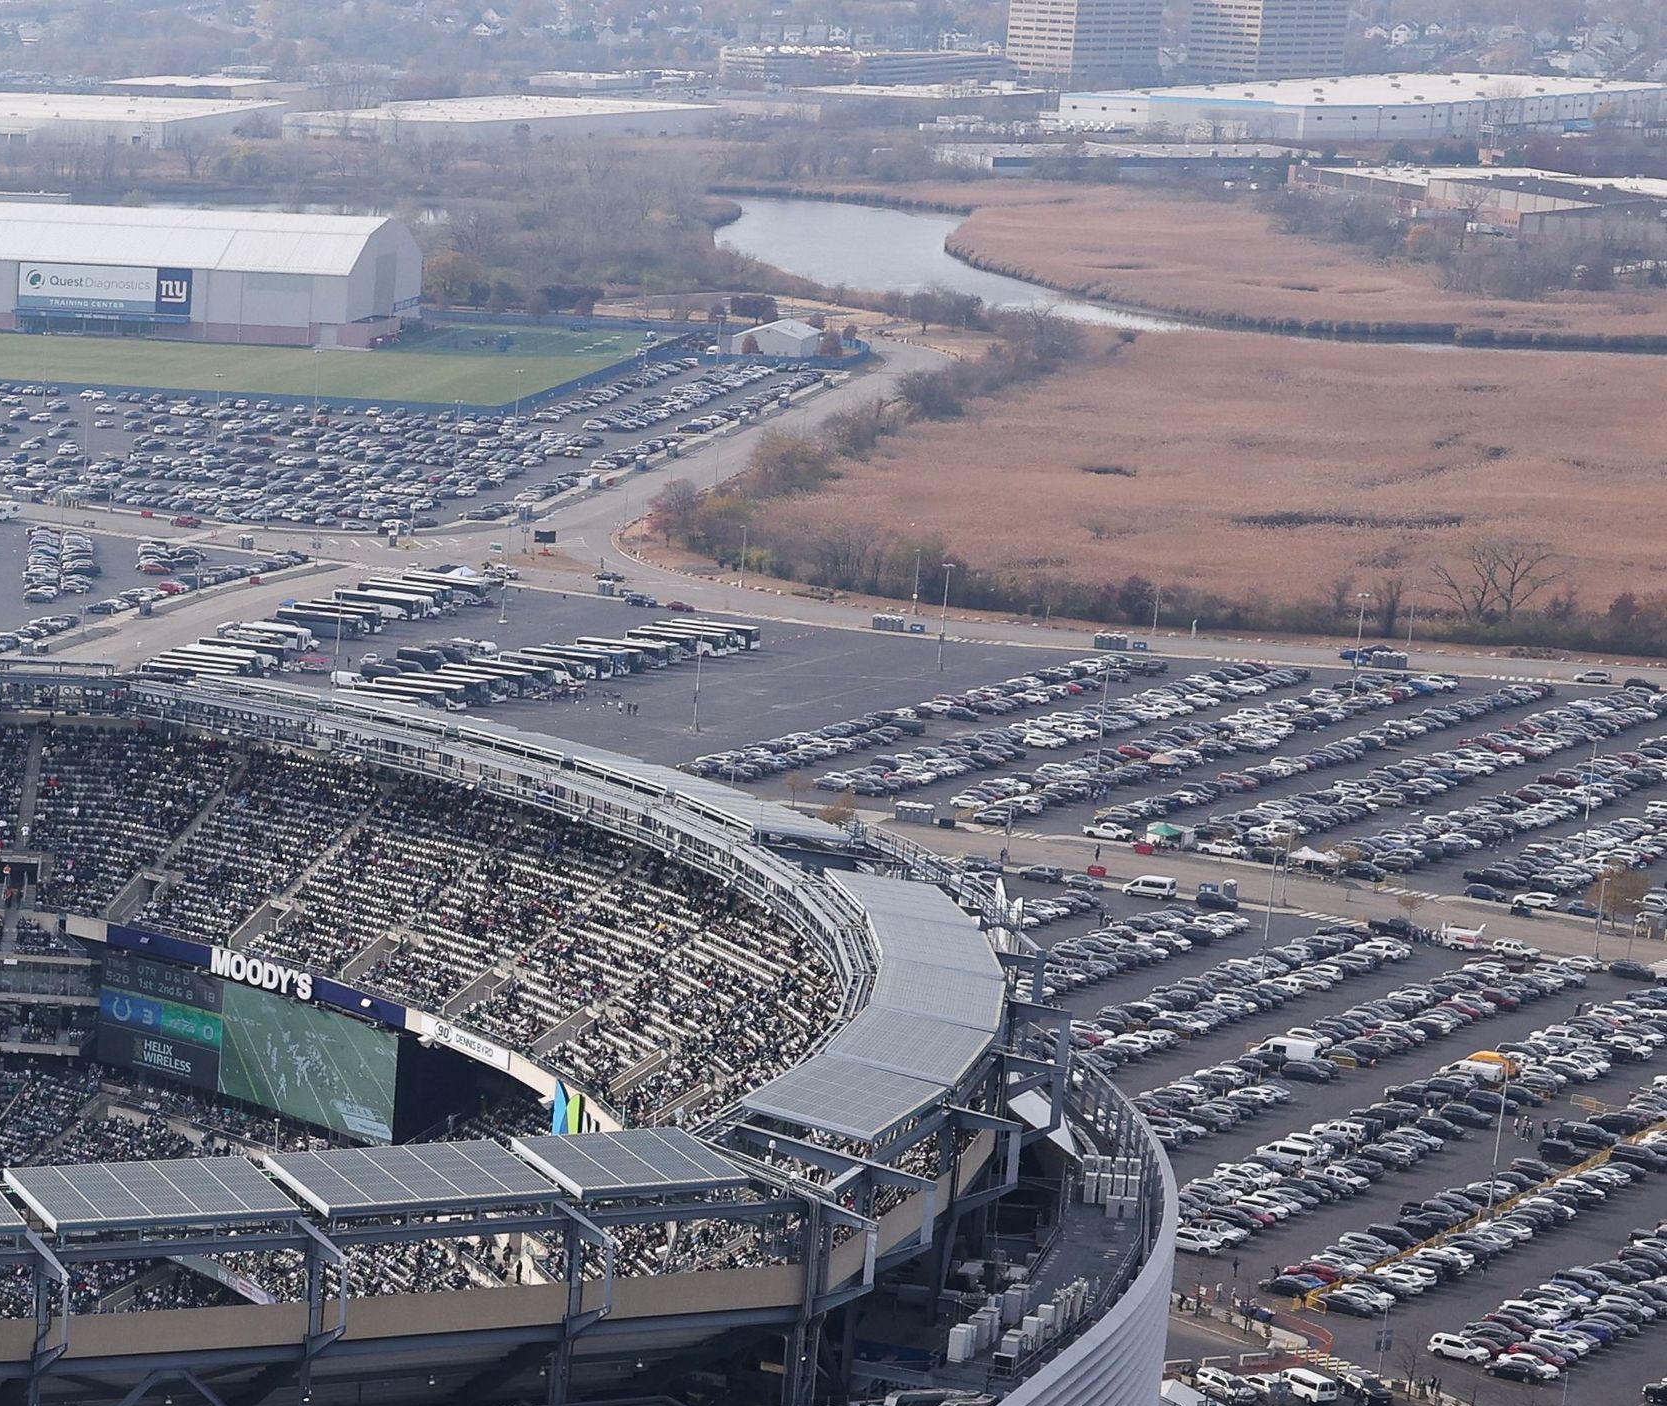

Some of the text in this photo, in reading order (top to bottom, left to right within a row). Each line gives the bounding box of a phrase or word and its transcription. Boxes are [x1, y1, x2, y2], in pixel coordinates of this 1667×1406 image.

[49, 275, 151, 291] Quest Diagnostics
[160, 279, 187, 303] ny
[49, 298, 124, 309] TRAINING CENTER
[106, 970, 130, 984] 5:20
[210, 945, 313, 1001] MOODY'S
[142, 1009, 154, 1025] 3
[203, 1025, 214, 1040] 0
[143, 1039, 173, 1056] HELIX
[142, 1050, 192, 1073] WIRELESS
